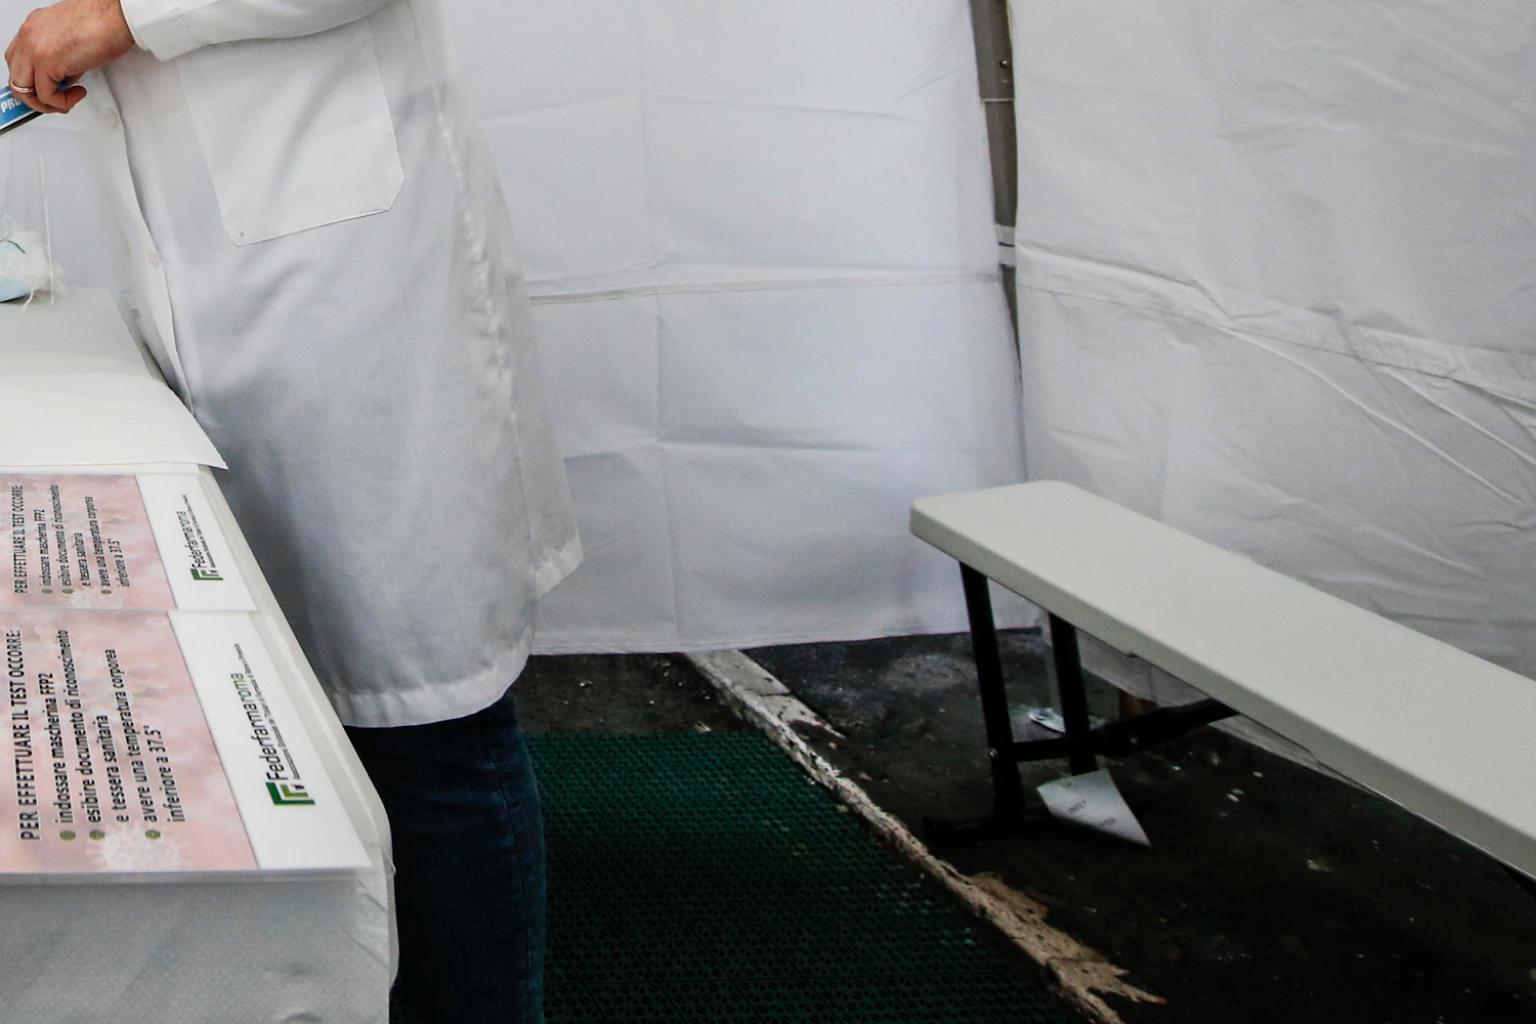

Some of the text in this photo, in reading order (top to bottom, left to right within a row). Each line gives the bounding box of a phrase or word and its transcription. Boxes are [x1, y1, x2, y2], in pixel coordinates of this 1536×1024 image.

[34, 509, 45, 521] FFP2
[13, 514, 28, 593] PER EFFETTUARE TEST
[10, 681, 27, 707] TEST
[12, 710, 29, 721] IL
[38, 673, 74, 824] indossare mascherina FFP2
[57, 630, 102, 822] esibire documento di riconoscimento
[93, 715, 117, 763] sanitaria
[105, 649, 158, 822] avere una temperatura corporea
[231, 673, 288, 780] Federfarmaroma
[13, 723, 37, 806] EFFETTUARE
[106, 766, 127, 811] tessera
[159, 766, 186, 823] inferiore
[20, 811, 40, 840] PER
